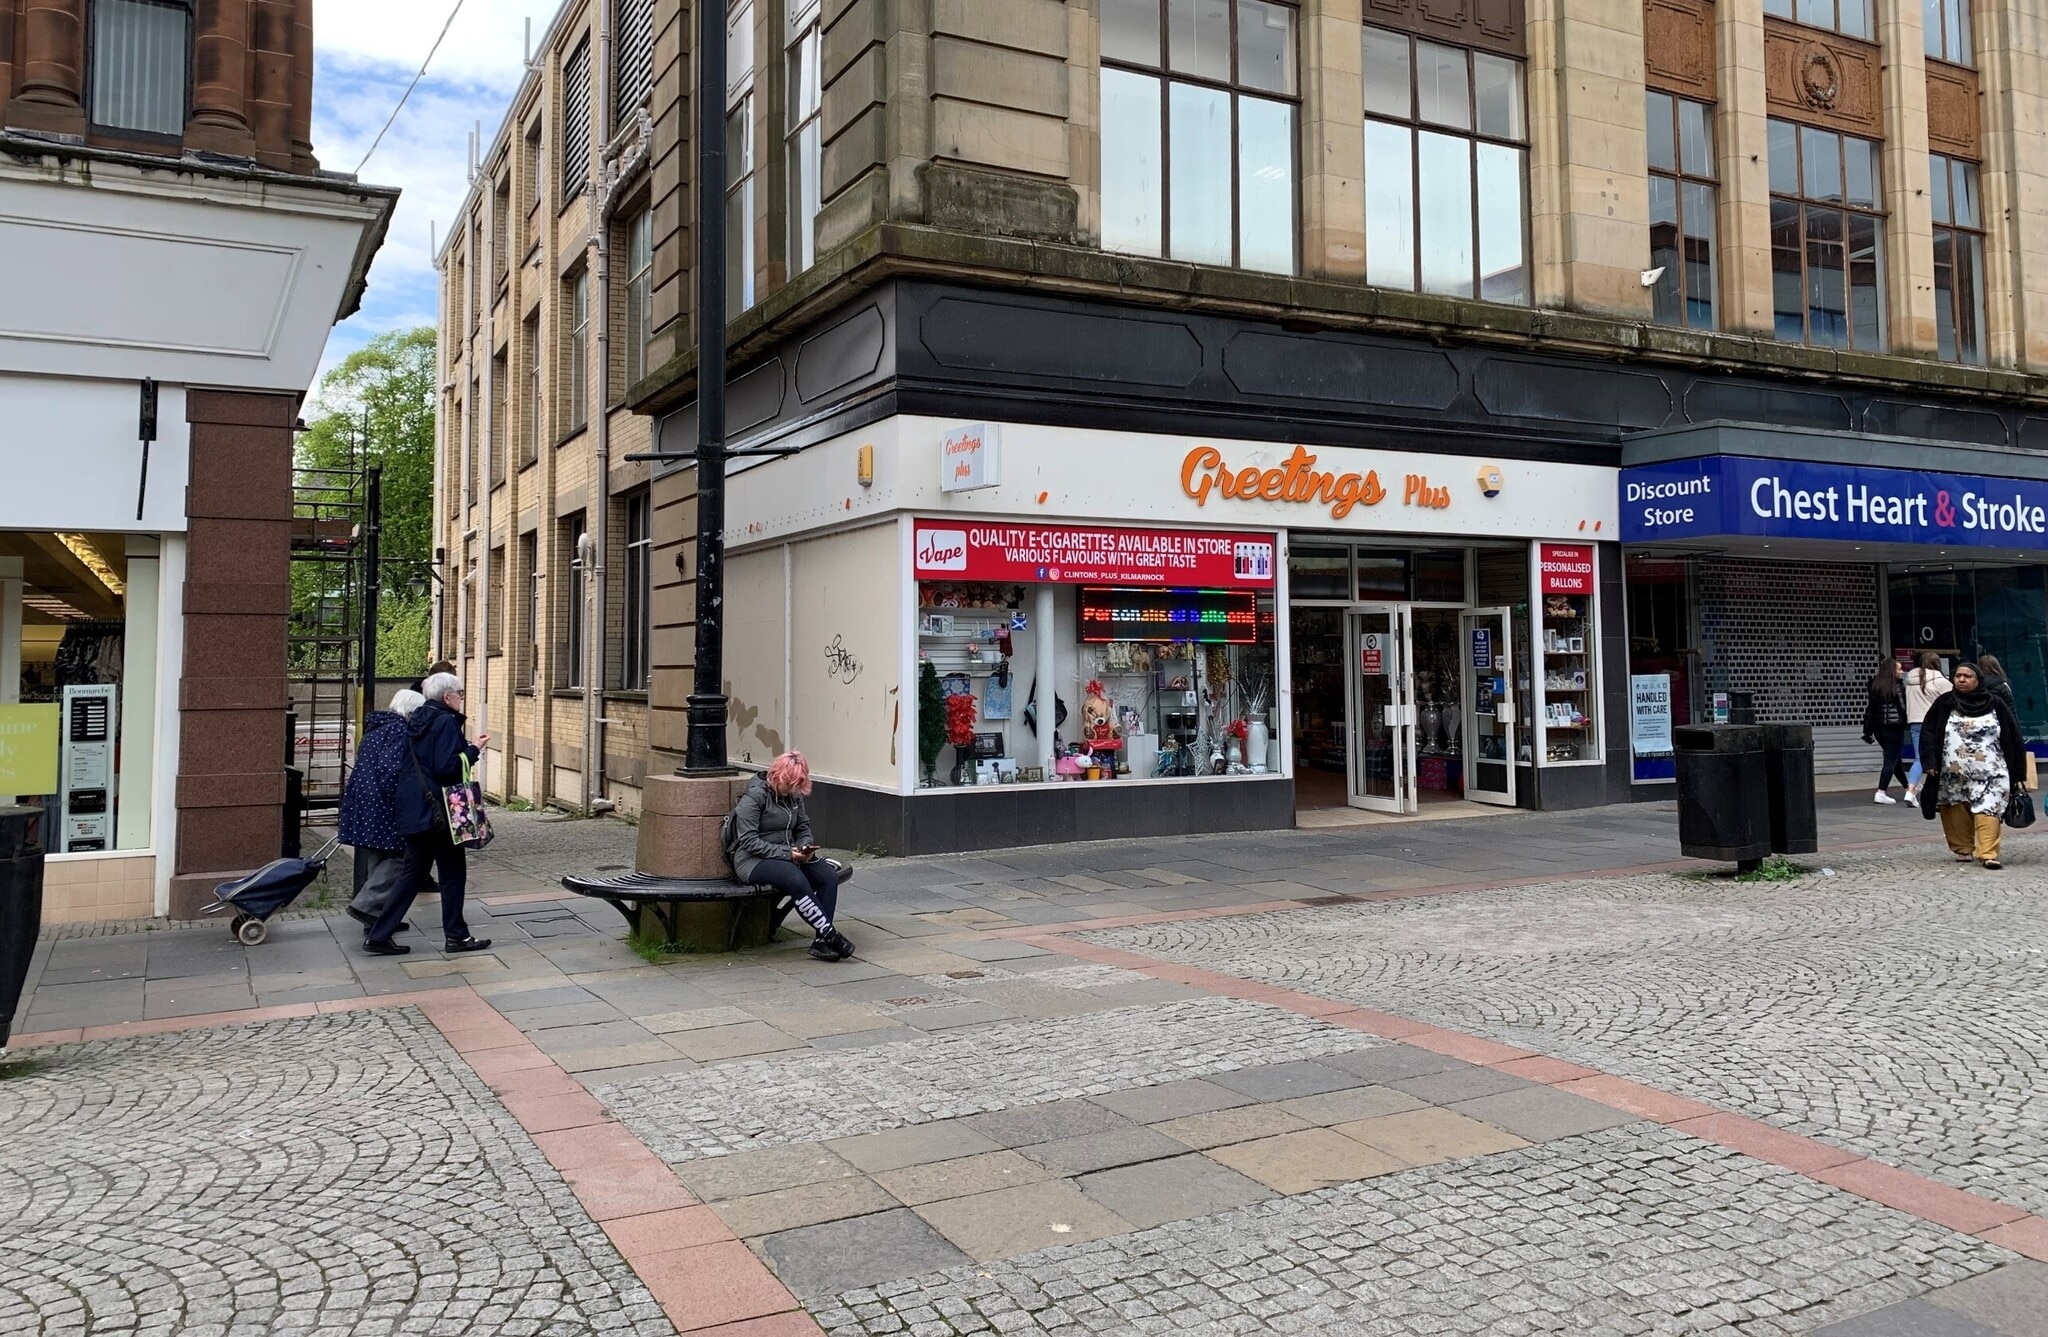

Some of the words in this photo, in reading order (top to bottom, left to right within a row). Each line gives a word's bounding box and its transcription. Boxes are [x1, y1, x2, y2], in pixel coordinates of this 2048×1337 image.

[946, 433, 981, 458] Greetings
[954, 460, 971, 483] plus
[1180, 444, 1386, 519] Greetings
[1404, 474, 1451, 509] Plus
[1626, 475, 1711, 502] Discount
[1750, 476, 1839, 522] Chest
[1846, 484, 1928, 527] Heart
[1934, 489, 1956, 528] &
[1962, 492, 2046, 533] Stroke
[1644, 507, 1694, 527] Store
[920, 531, 964, 564] Vape
[969, 528, 1026, 548] QUALITY
[1029, 530, 1115, 551] E-CIGARETTES
[1118, 534, 1182, 554] AVAILABLE
[1183, 537, 1196, 554] IN
[1197, 537, 1232, 555] STORE
[1005, 548, 1050, 563] VARIOUS
[1052, 549, 1106, 565] FLAVOURS
[1107, 551, 1134, 566] WITH
[1135, 552, 1165, 567] GREAT
[1166, 554, 1197, 568] TASTE
[1539, 562, 1591, 573] PERSONALISED
[1550, 577, 1583, 589] BALLONS
[1636, 692, 1667, 704] HANDLED
[1636, 705, 1652, 715] WITH
[1653, 704, 1667, 714] CARE
[795, 895, 823, 922] JUST
